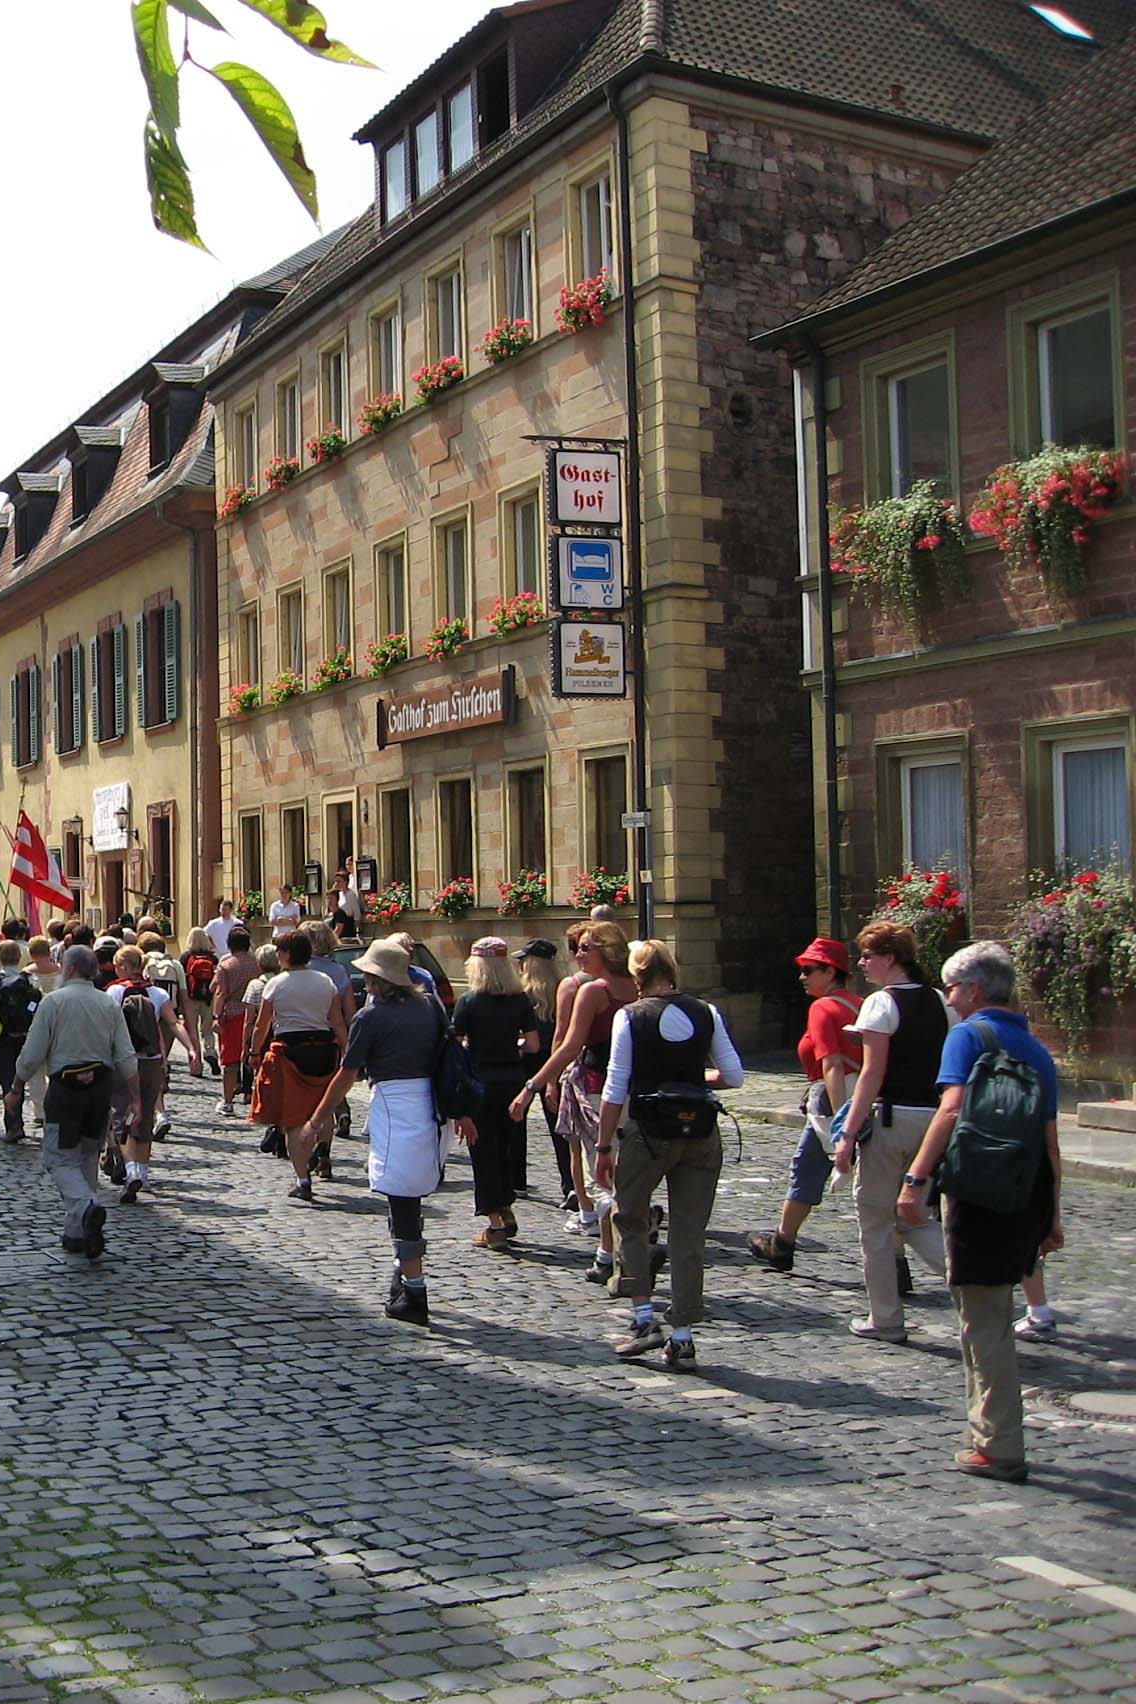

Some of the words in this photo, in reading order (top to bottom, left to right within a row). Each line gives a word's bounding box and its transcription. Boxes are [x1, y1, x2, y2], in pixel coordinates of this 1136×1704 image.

[559, 464, 616, 483] Gast-
[574, 488, 604, 513] hof
[426, 700, 449, 728] zum
